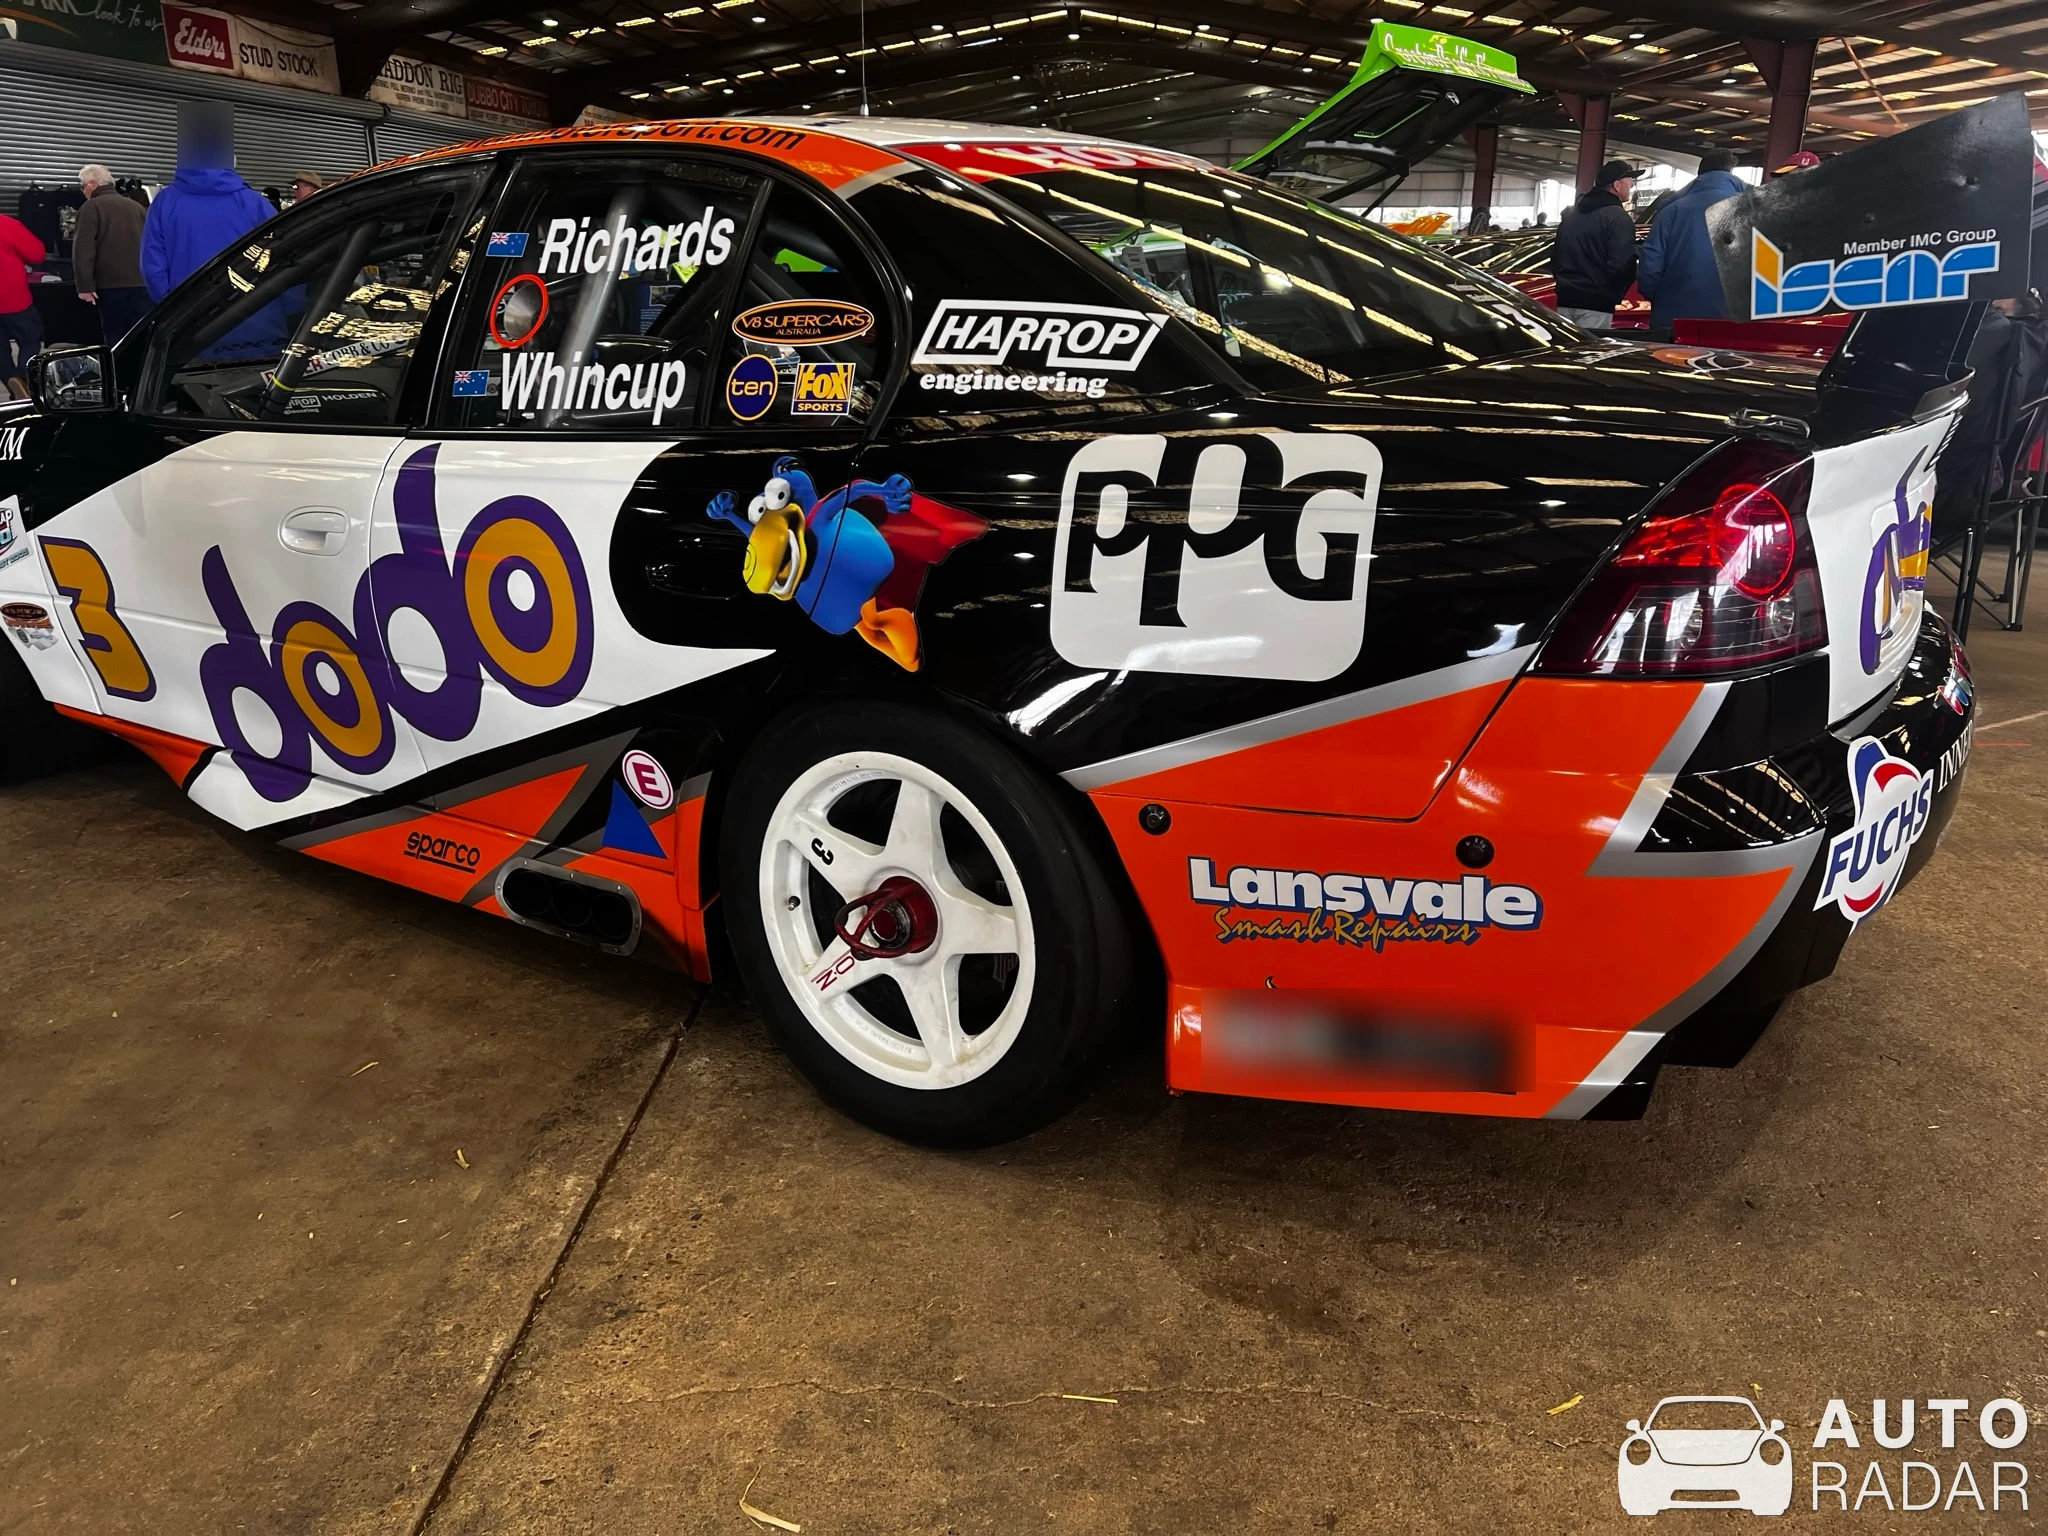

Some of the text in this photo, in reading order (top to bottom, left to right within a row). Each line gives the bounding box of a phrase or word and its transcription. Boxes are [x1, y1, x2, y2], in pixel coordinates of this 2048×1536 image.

[174, 18, 226, 60] Elders
[239, 43, 318, 76] STUD STOCK
[380, 58, 463, 94] ADDON RIG
[466, 81, 499, 109] DUBBO
[500, 90, 519, 113] CITY
[538, 206, 735, 274] Richards
[1843, 228, 1997, 255] Member IMC Group
[740, 314, 871, 329] V8 SUPERCARS
[775, 328, 822, 336] AUSTRALIA
[935, 315, 1141, 366] HARROP
[321, 391, 379, 402] HOLDEN
[501, 351, 687, 426] Whincup
[731, 378, 774, 396] ten
[799, 371, 849, 400] FOX
[919, 369, 1109, 398] engineering
[797, 403, 844, 412] SPORTS
[37, 534, 157, 702] 3
[200, 441, 595, 802] dodo
[631, 761, 664, 799] E
[406, 831, 481, 867] sparco
[1822, 778, 1931, 898] FUCHS
[1190, 857, 1540, 927] Lansvale
[1214, 906, 1478, 950] Smash Repairs
